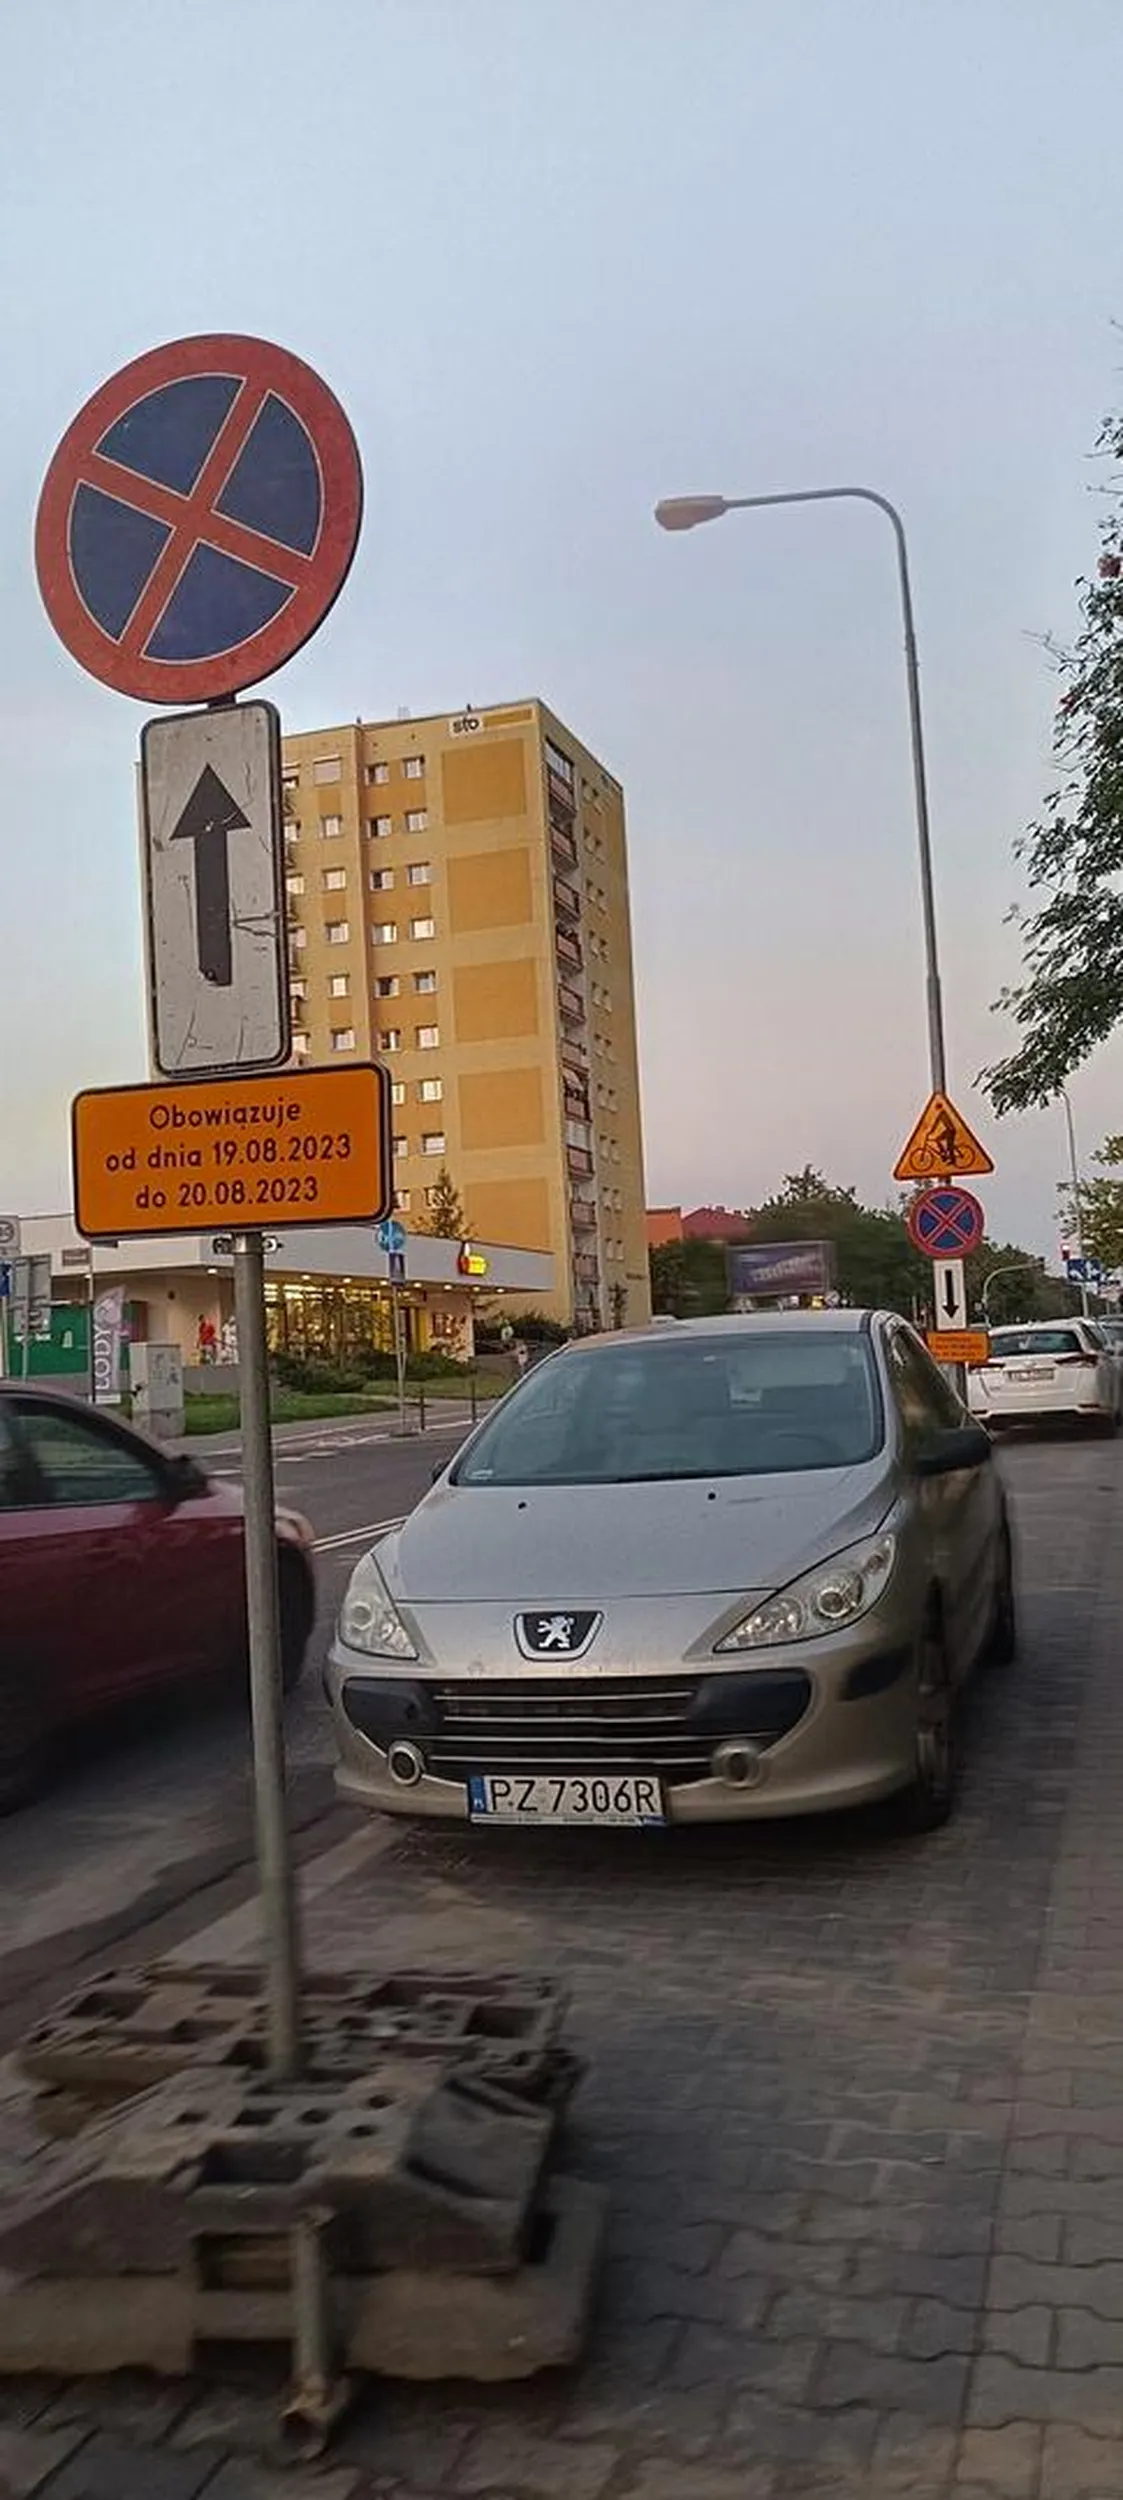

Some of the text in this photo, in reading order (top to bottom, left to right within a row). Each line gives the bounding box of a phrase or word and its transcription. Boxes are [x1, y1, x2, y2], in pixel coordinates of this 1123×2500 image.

[453, 716, 479, 733] sto
[150, 1097, 301, 1130] Obowiązuje
[106, 1134, 352, 1172] od dnia 19.08.2023
[135, 1176, 319, 1209] do 20.08.2023
[490, 1779, 656, 1813] PZ 7306R
